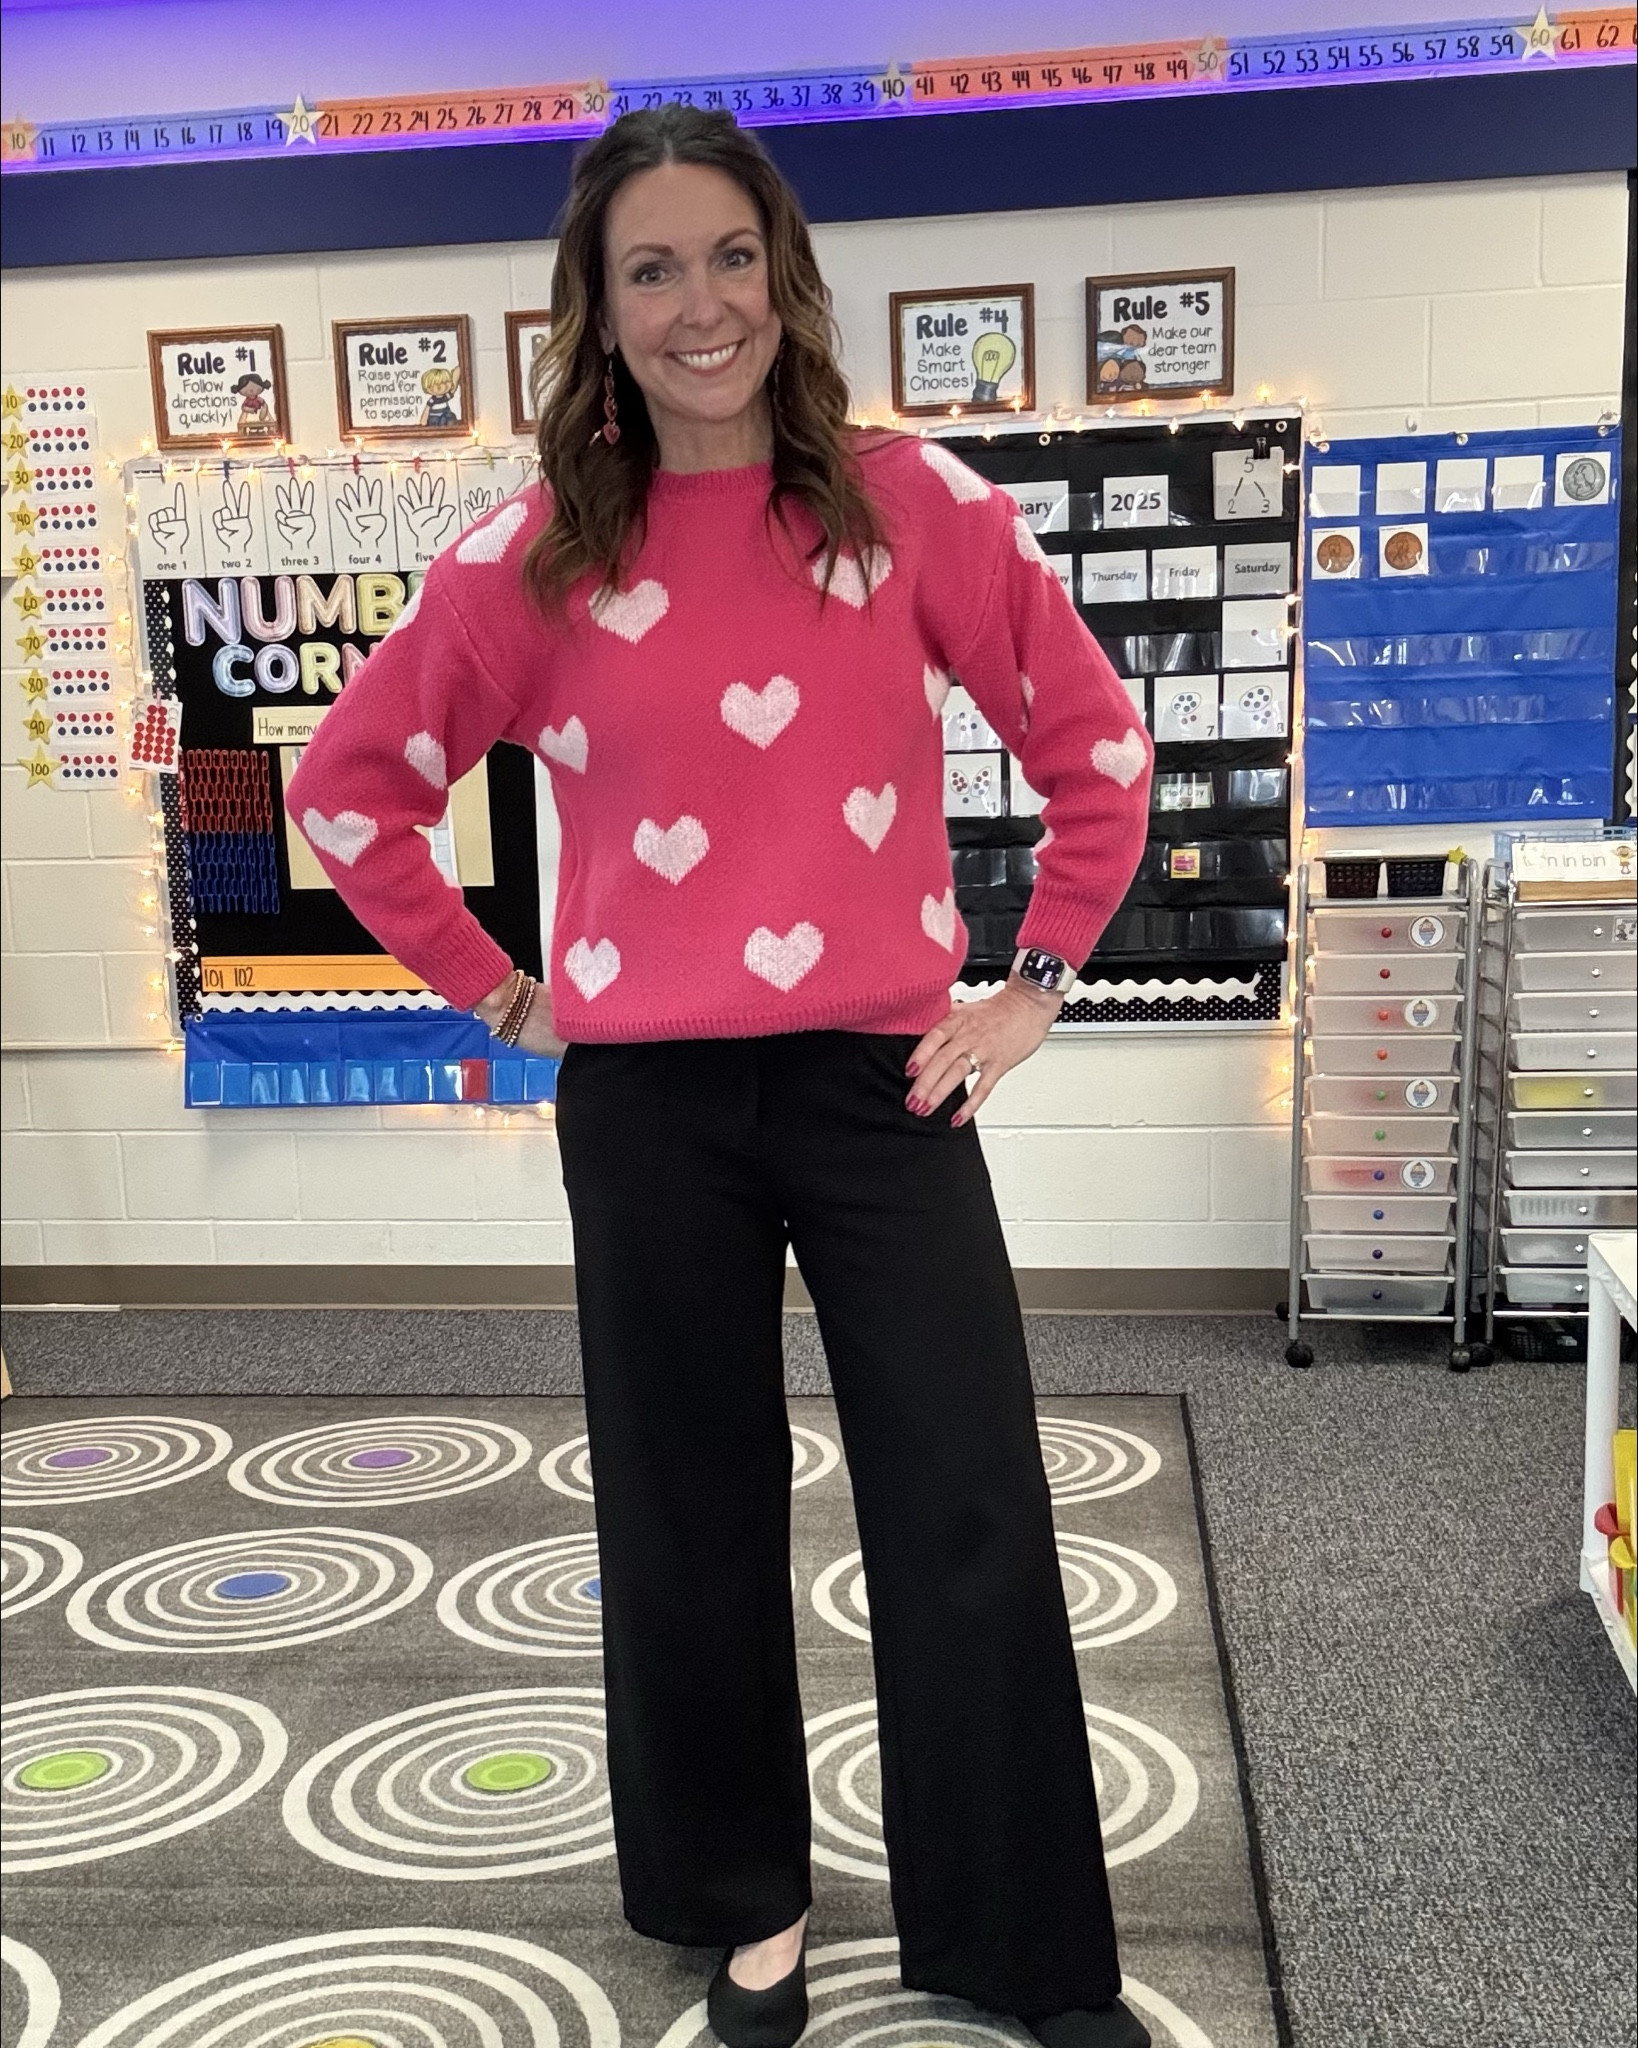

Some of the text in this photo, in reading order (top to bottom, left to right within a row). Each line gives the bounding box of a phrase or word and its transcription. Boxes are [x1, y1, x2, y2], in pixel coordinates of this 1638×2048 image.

[12, 133, 26, 150] 10
[42, 137, 54, 156] 11
[72, 134, 86, 153] 12
[98, 131, 114, 151] 13
[124, 129, 140, 151] 14
[154, 128, 170, 148] 15
[182, 126, 196, 146] 16
[210, 124, 223, 144] 17
[238, 122, 253, 141] 18
[266, 119, 283, 139] 19
[292, 115, 309, 133] 20
[321, 114, 339, 136] 21
[353, 112, 374, 134] 22
[380, 112, 402, 132] 23
[407, 110, 428, 132] 24
[437, 108, 458, 129] 25
[466, 106, 486, 127] 26
[493, 104, 513, 124] 27
[523, 101, 542, 120] 28
[552, 98, 574, 120] 29
[583, 92, 604, 113] 30
[614, 95, 629, 118] 31
[703, 90, 722, 110] 34
[731, 88, 753, 110] 35
[760, 87, 784, 109] 36
[791, 86, 811, 107] 37
[820, 84, 843, 104] 38
[852, 80, 875, 102] 39
[882, 79, 905, 99] 40
[916, 76, 934, 95] 41
[950, 74, 970, 94] 42
[982, 71, 1002, 92] 43
[1012, 70, 1030, 89] 44
[1042, 68, 1062, 87] 45
[1072, 67, 1092, 84] 46
[1103, 65, 1122, 84] 47
[1134, 62, 1155, 80] 48
[1166, 60, 1188, 80] 49
[1198, 52, 1218, 72] 50
[1230, 52, 1249, 76] 51
[1262, 50, 1285, 75] 52
[1296, 49, 1319, 73] 53
[1328, 46, 1350, 70] 54
[1359, 44, 1383, 66] 55
[1392, 42, 1414, 64] 56
[1424, 39, 1446, 60] 57
[1457, 36, 1480, 59] 58
[1490, 34, 1514, 56] 59
[1530, 28, 1550, 48] 60
[1560, 28, 1580, 50] 61
[1596, 24, 1619, 47] 62
[1114, 291, 1210, 322] Rule #5
[916, 307, 1009, 340] Rule #4
[1152, 326, 1212, 340] Make our
[358, 337, 447, 366] Rule #2
[922, 342, 961, 358] Make
[1148, 342, 1216, 357] dear team
[178, 346, 256, 376] Rule #1
[917, 358, 966, 374] Smart
[1154, 360, 1211, 374] stronger
[358, 370, 420, 382] Raise your
[910, 372, 974, 392] Choices!
[182, 379, 224, 393] Follow
[367, 381, 416, 394] hand for
[6, 394, 18, 408] 10
[172, 394, 238, 409] directions
[360, 394, 423, 410] permission
[179, 409, 233, 428] quickly!
[365, 407, 418, 422] to speak!
[10, 436, 24, 448] 20
[1244, 456, 1254, 473] 5
[15, 472, 28, 484] 30
[1110, 492, 1161, 512] 2025
[1228, 498, 1270, 514] 2 3
[16, 514, 30, 526] 40
[221, 558, 252, 568] two 2
[281, 556, 320, 566] three 3
[348, 554, 382, 564] four 4
[415, 552, 435, 562] five
[20, 558, 34, 571] 50
[157, 560, 187, 570] one 1
[1234, 562, 1280, 574] Saturday
[1092, 570, 1138, 582] Thursday
[1169, 566, 1200, 578] Friday
[24, 598, 38, 610] 60
[26, 636, 40, 650] 70
[1276, 650, 1282, 662] 1
[28, 680, 43, 692] 80
[30, 720, 44, 734] 90
[258, 717, 284, 736] How
[1206, 726, 1215, 736] 7
[31, 764, 50, 776] 100
[1562, 854, 1577, 868] in
[1582, 854, 1606, 867] bin
[204, 966, 256, 990] 101 102
